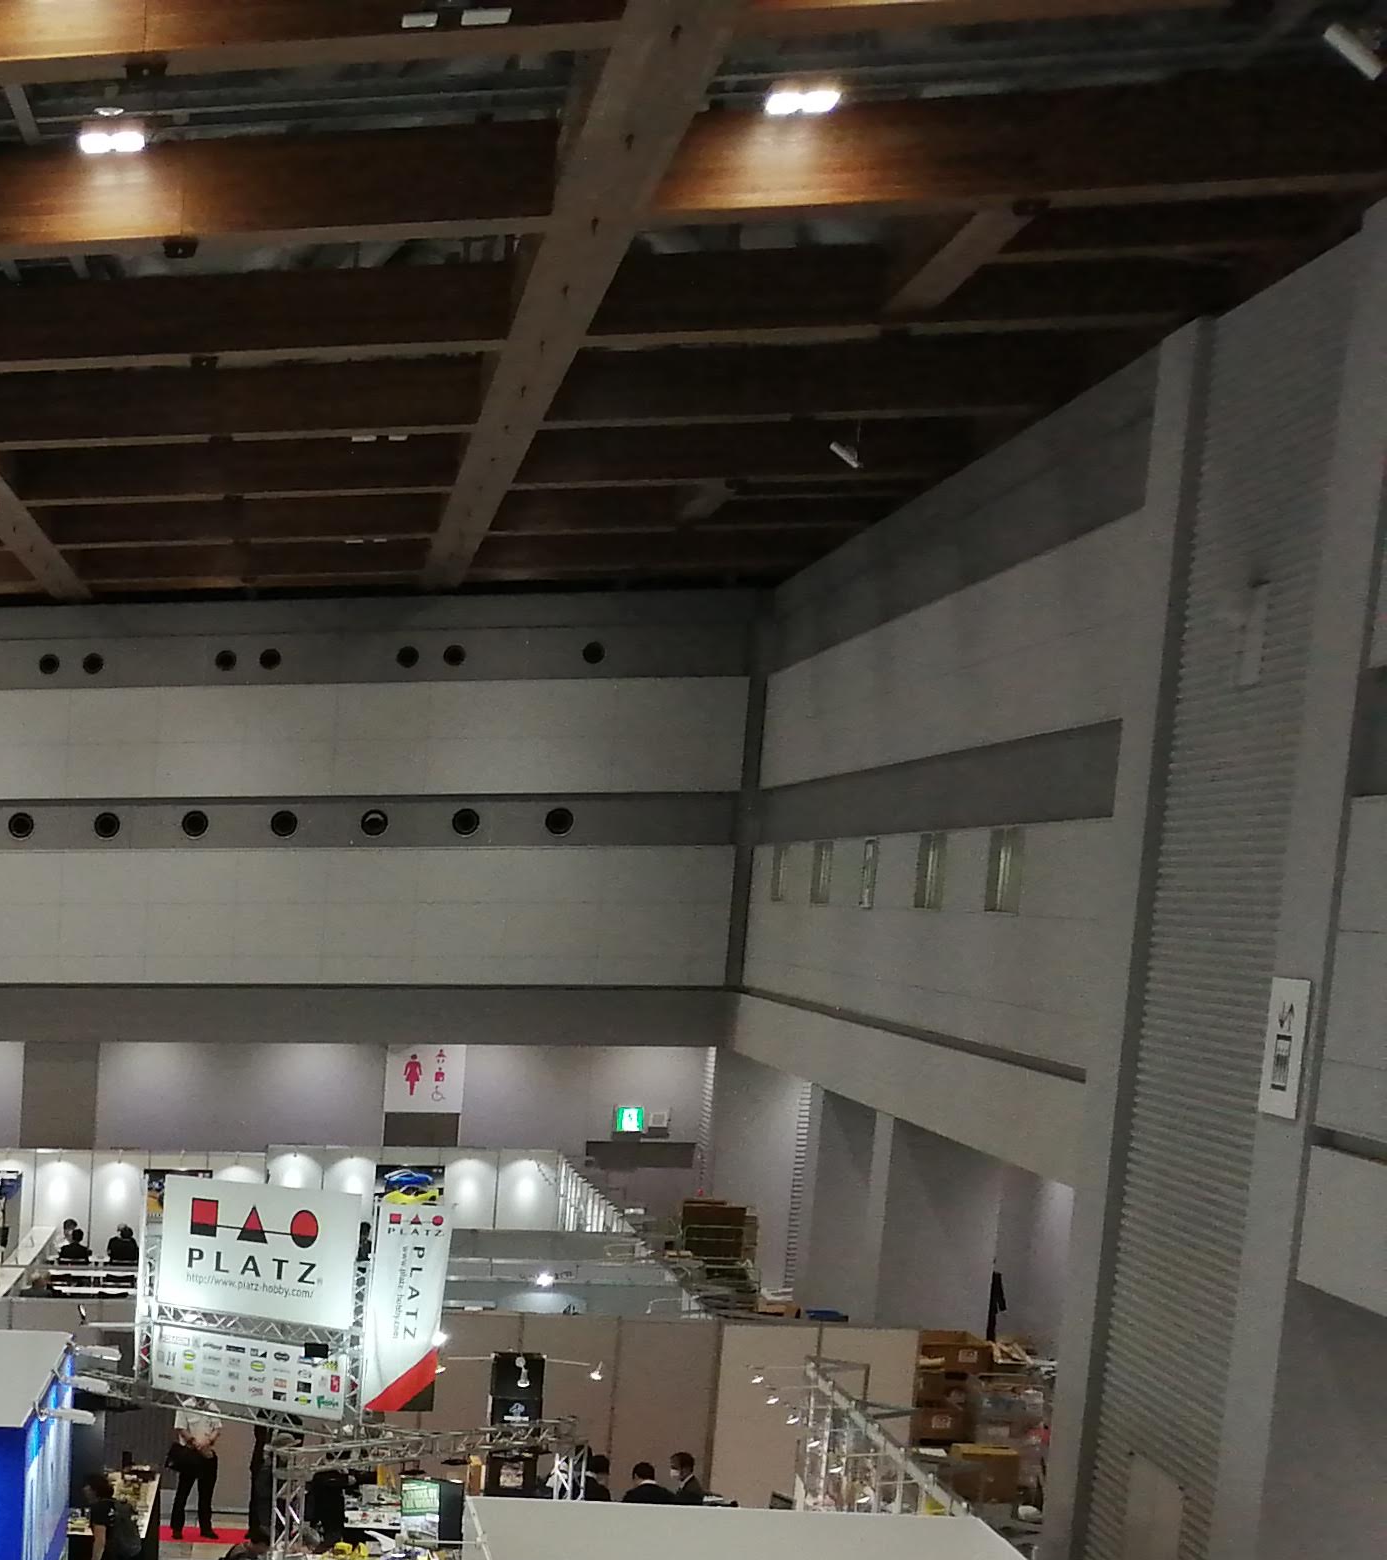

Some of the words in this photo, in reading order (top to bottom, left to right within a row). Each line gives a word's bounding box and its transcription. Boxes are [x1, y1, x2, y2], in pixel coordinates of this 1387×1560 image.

[387, 1227, 445, 1237] PLATZ
[187, 1247, 317, 1285] PLATZ
[403, 1246, 426, 1341] PLATZ
